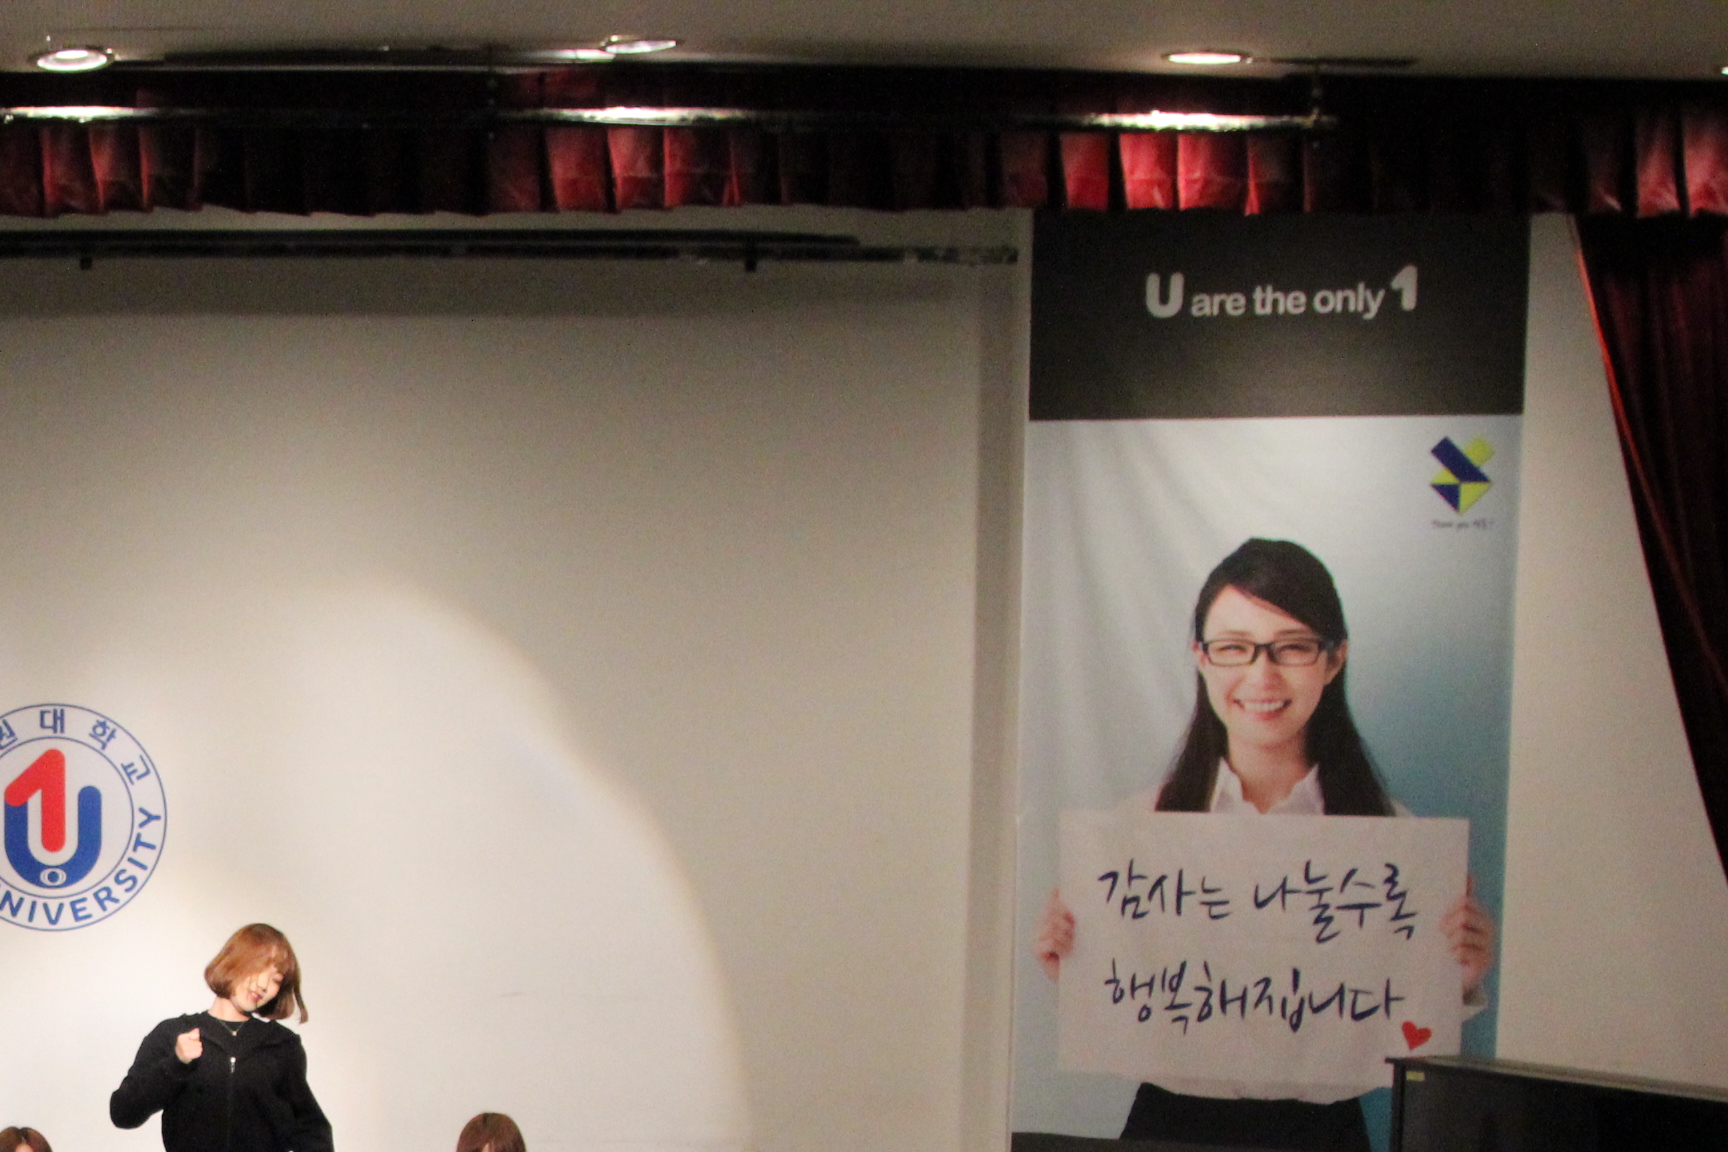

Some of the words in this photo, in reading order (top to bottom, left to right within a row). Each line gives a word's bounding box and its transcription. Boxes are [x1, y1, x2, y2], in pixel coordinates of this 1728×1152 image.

[1145, 271, 1184, 318] U
[1190, 293, 1246, 317] are
[1252, 285, 1307, 315] the
[1312, 282, 1385, 320] only
[1390, 265, 1418, 311] 1
[1098, 859, 1230, 920] 감사는
[1254, 859, 1420, 943] 나눌수록
[1104, 957, 1405, 1035] 행복해집니다
